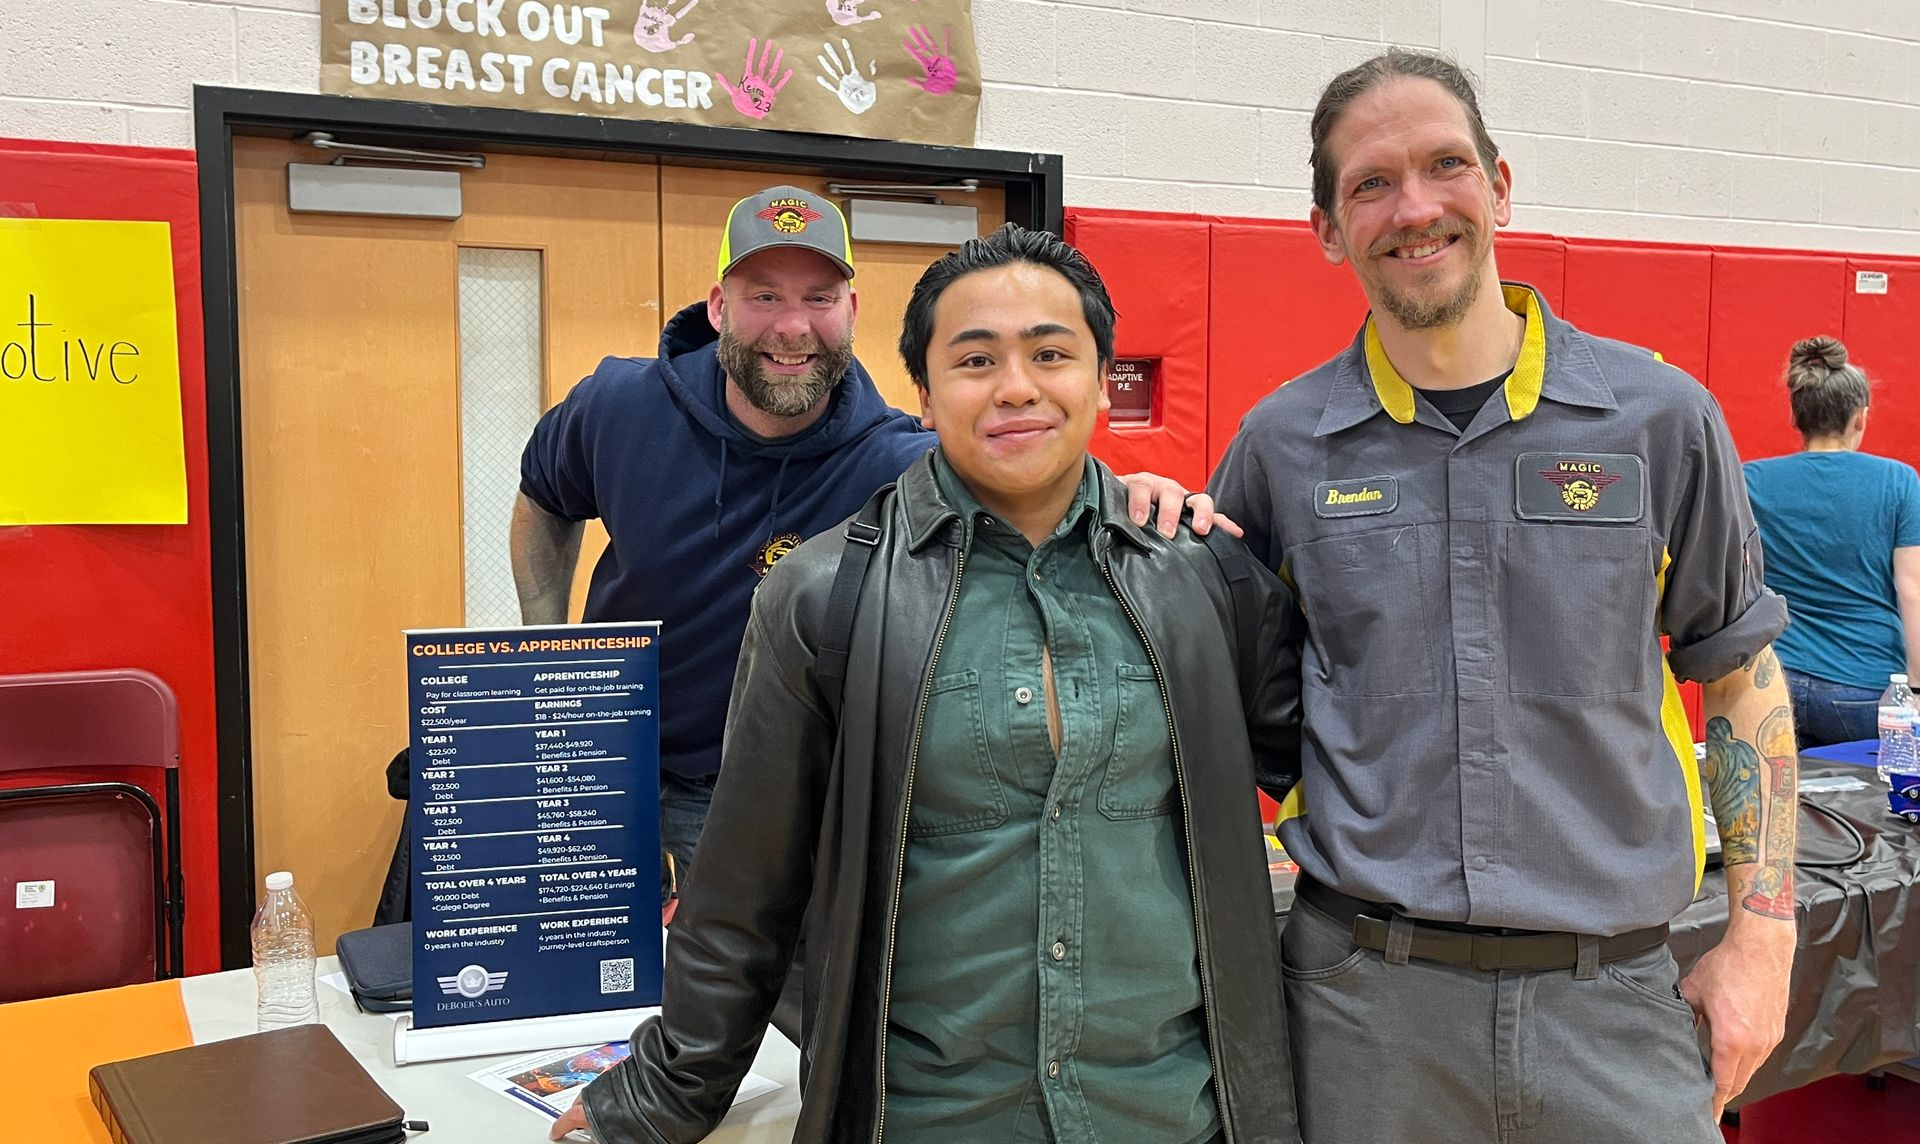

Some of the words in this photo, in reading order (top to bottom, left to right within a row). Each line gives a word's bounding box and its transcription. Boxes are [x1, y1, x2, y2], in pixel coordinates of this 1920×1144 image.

[348, 0, 506, 37] BLOCK
[516, 0, 609, 48] OUT
[350, 40, 532, 95] BREAST
[542, 57, 712, 110] CANCER
[738, 76, 764, 97] Keira
[772, 199, 807, 208] MAGIC
[1559, 463, 1601, 472] MAGIC
[1325, 487, 1382, 504] Brendan
[413, 644, 485, 656] COLLEGE
[490, 642, 514, 654] VS.
[518, 636, 651, 652] APPRENTICESHIP
[421, 676, 468, 685] COLLEGE
[534, 670, 620, 682] APPRENTICESHIP
[426, 691, 439, 699] Pay
[491, 688, 521, 697] learning
[550, 685, 564, 694] paid
[578, 684, 615, 693] on-the-job
[616, 683, 643, 691] training
[535, 700, 582, 709] EARNINGS
[421, 706, 446, 714] COST
[552, 711, 584, 720] $24/hour
[586, 710, 623, 719] on-the-job
[624, 709, 651, 717] training
[535, 730, 560, 738] YEAR
[422, 736, 446, 744] YEAR
[541, 750, 570, 759] Benefits
[578, 748, 607, 757] Pension
[432, 757, 450, 766] Debt
[536, 765, 560, 773] YEAR
[422, 771, 446, 780] YEAR
[543, 785, 571, 795] Benefits
[580, 784, 608, 792] Pension
[423, 806, 448, 814] YEAR
[537, 835, 561, 843] YEAR
[423, 842, 448, 850] YEAR
[579, 853, 607, 862] Pension
[540, 874, 570, 882] TOTAL
[572, 871, 597, 880] OVER
[608, 868, 637, 877] YEARS
[426, 882, 457, 890] TOTAL
[459, 880, 485, 888] OVER
[495, 876, 526, 885] YEARS
[604, 881, 635, 890] Earnings
[432, 893, 460, 902] -90,000
[580, 892, 608, 901] Pension
[463, 901, 490, 910] Degree
[540, 920, 570, 930] WORK
[572, 916, 628, 927] EXPERIENCE
[426, 929, 457, 939] WORK
[459, 924, 517, 936] EXPERIENCE
[545, 933, 564, 941] years
[587, 929, 616, 938] industry
[431, 942, 451, 952] years
[475, 938, 505, 947] industry
[539, 941, 584, 952] journey-level
[586, 938, 629, 949] craftsperson
